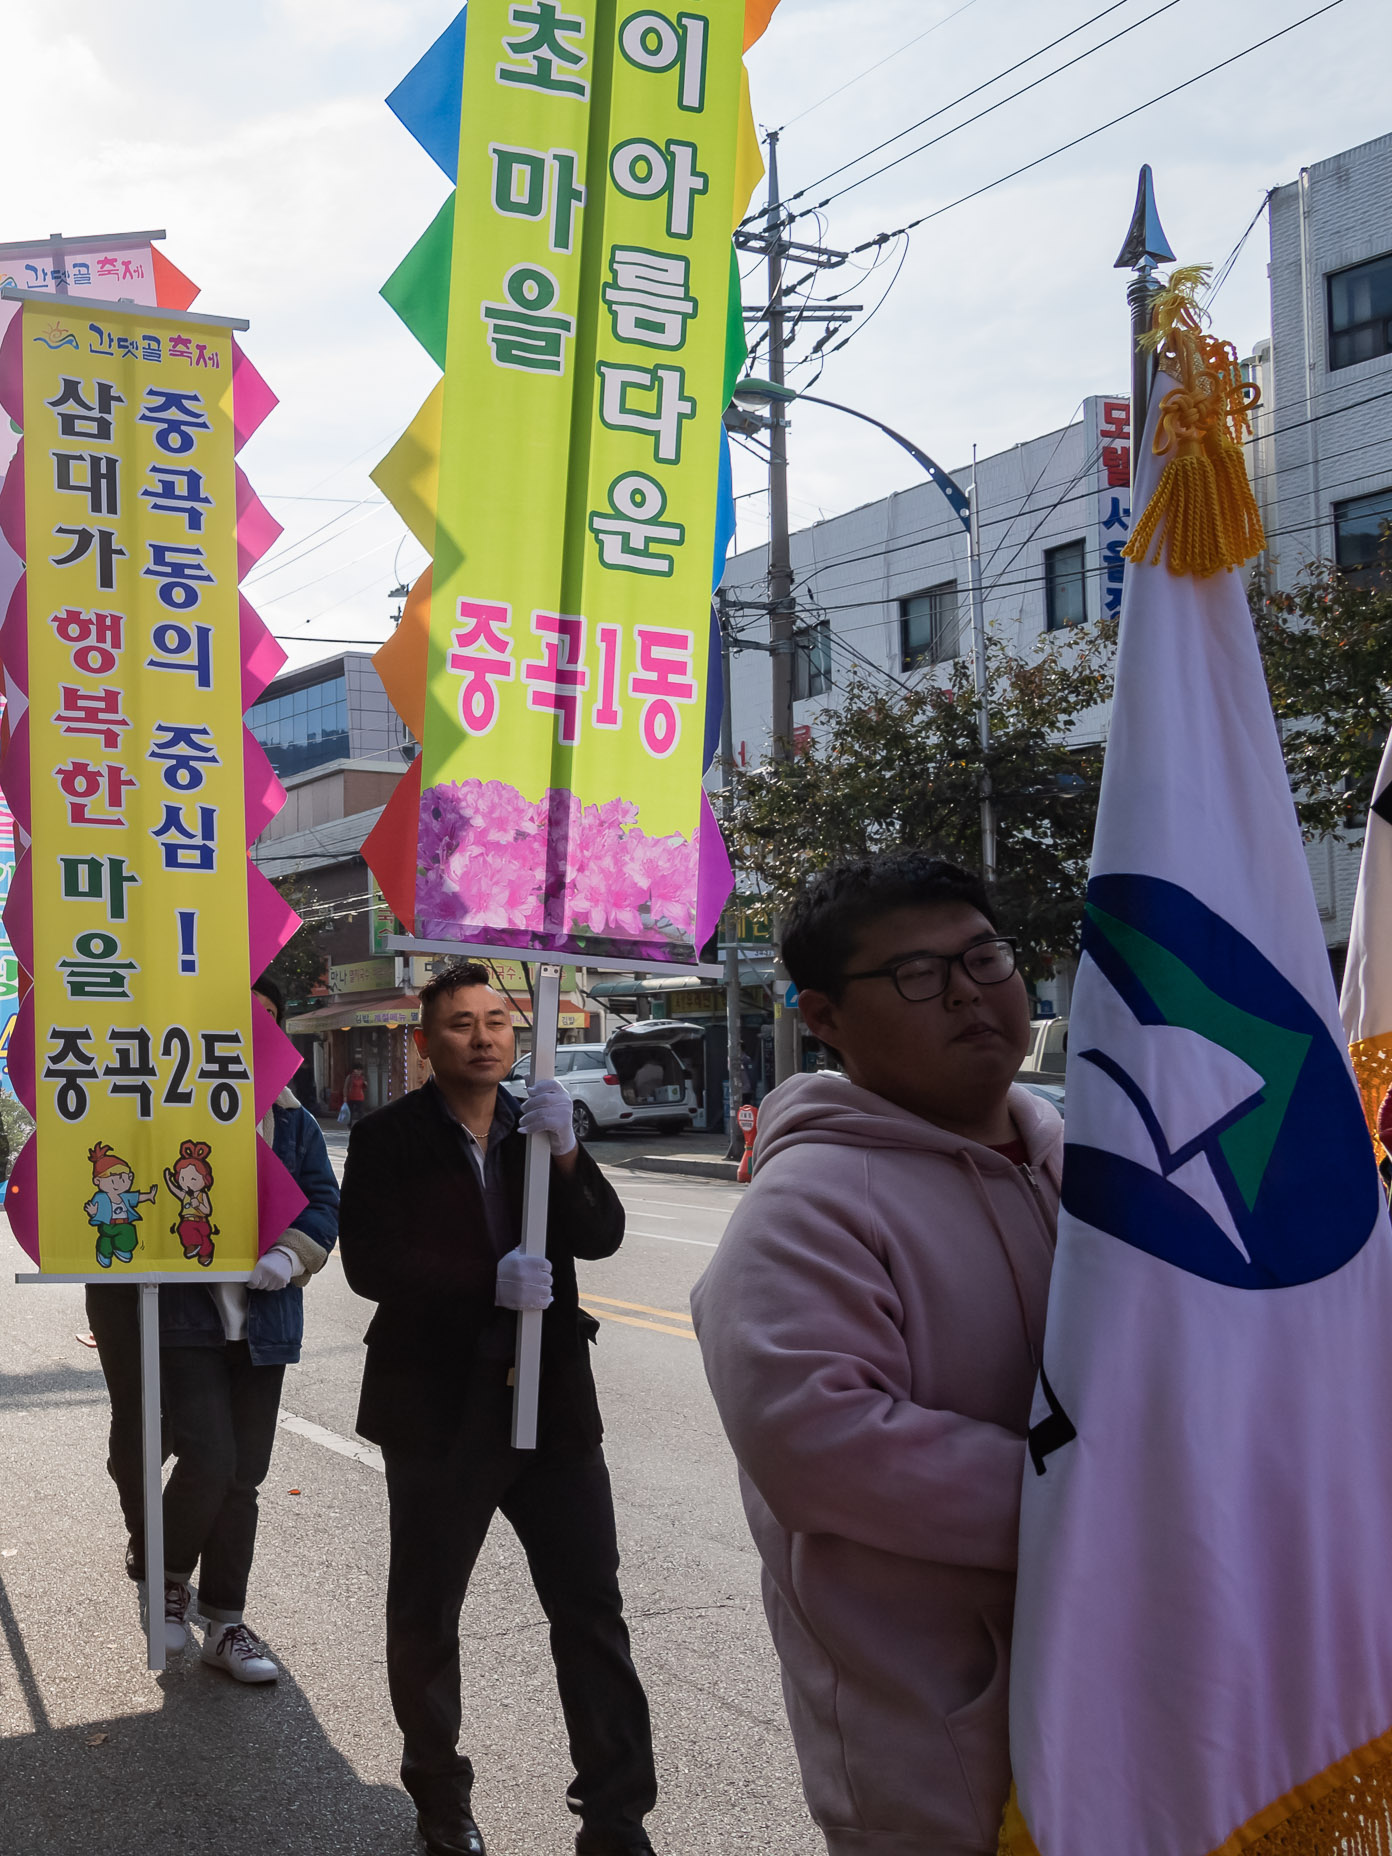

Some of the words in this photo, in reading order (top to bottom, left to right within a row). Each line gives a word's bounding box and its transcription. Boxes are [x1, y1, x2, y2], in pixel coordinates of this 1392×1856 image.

[619, 0, 709, 113] 이
[480, 141, 587, 376] 마을
[589, 137, 709, 578] 아름다운
[46, 376, 129, 591] 삼대가
[136, 386, 217, 691] 중곡동의
[49, 608, 138, 828] 행복한
[446, 596, 698, 760] 중곡1동
[57, 854, 140, 1000] 마을
[41, 1024, 253, 1123] 중곡2동
